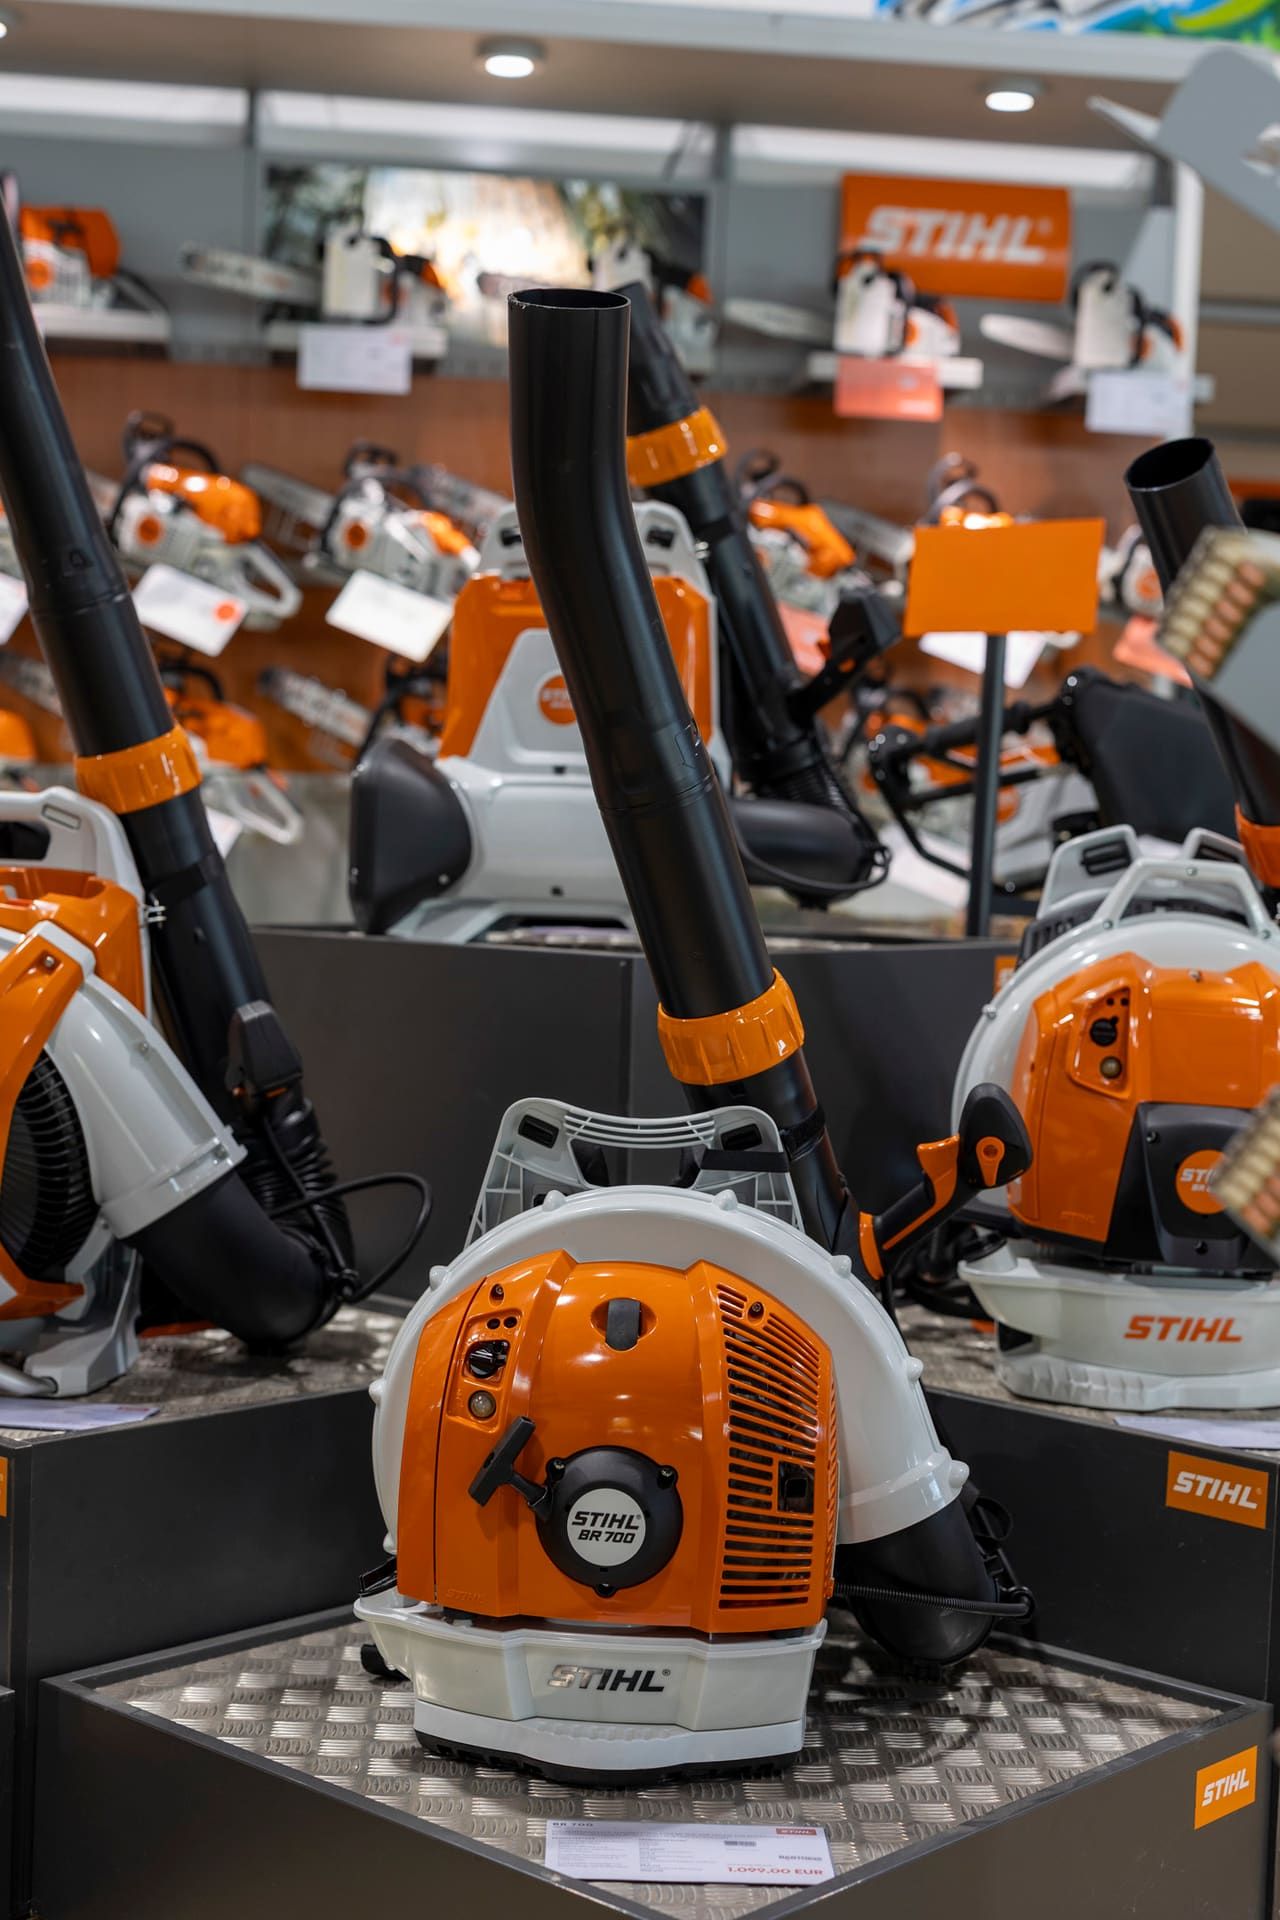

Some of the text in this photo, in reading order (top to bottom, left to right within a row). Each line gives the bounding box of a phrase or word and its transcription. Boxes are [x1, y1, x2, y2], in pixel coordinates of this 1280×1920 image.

[860, 205, 1045, 263] STIHL
[1124, 1315, 1242, 1342] STIHL
[1173, 1471, 1258, 1510] STIHL
[572, 1511, 639, 1530] STIHL
[578, 1529, 635, 1543] BR 700
[1202, 1768, 1250, 1807] STIHL
[728, 1866, 791, 1874] 1.099,00
